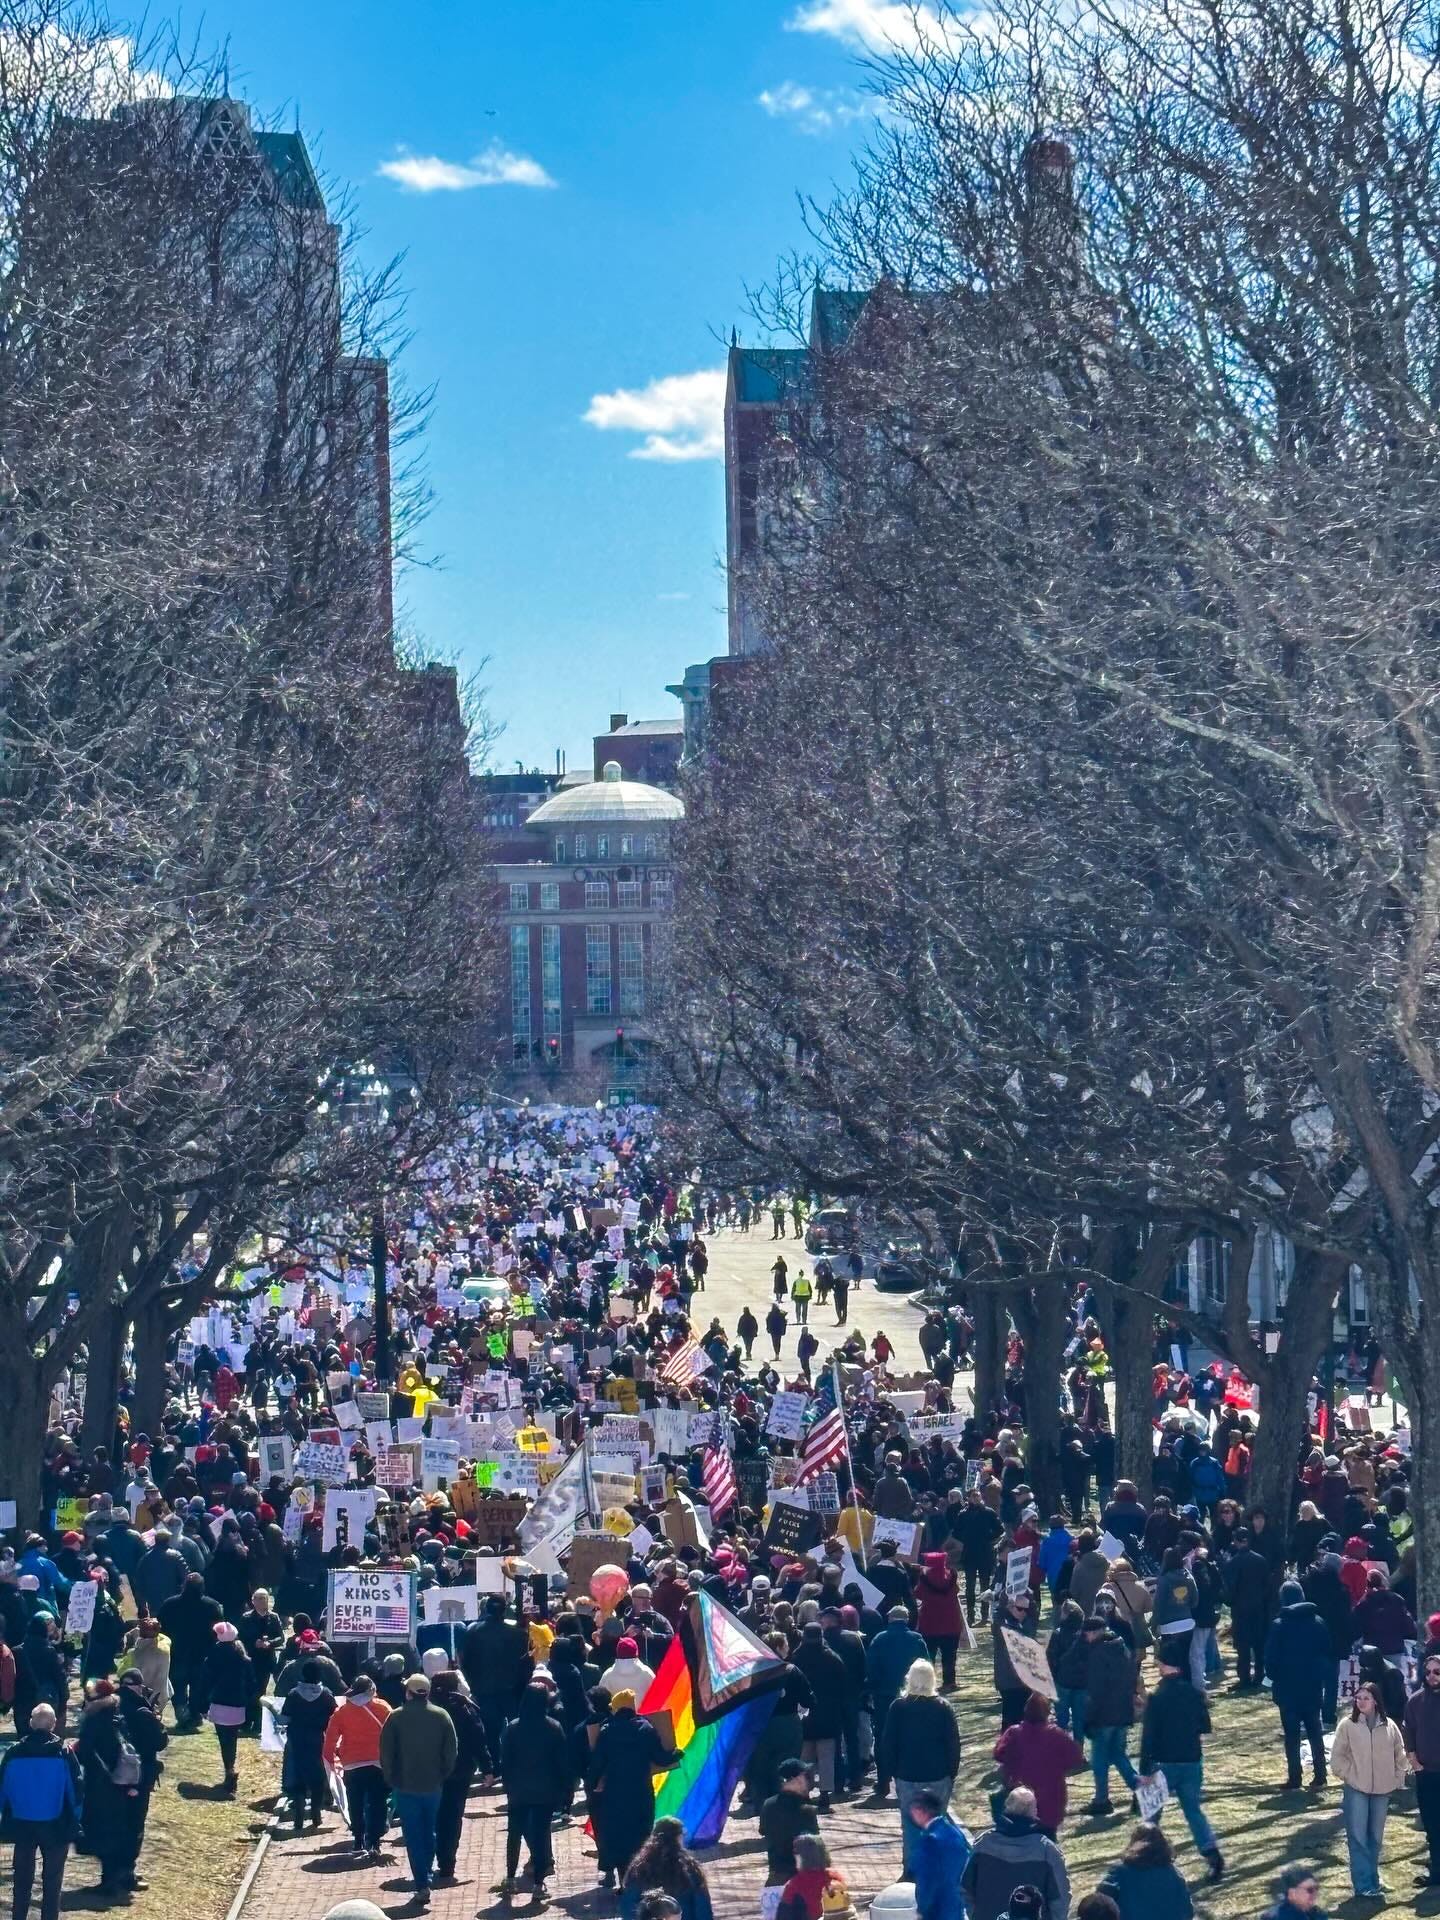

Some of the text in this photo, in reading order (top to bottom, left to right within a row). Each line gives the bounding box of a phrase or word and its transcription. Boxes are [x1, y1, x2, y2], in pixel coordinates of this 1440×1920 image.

[923, 1415, 955, 1429] ISRAEL
[783, 1509, 809, 1521] TRUMP
[778, 1517, 801, 1528] FUCKS
[360, 1574, 380, 1586] NO
[345, 1587, 391, 1601] KINGS
[335, 1605, 373, 1617] EVER
